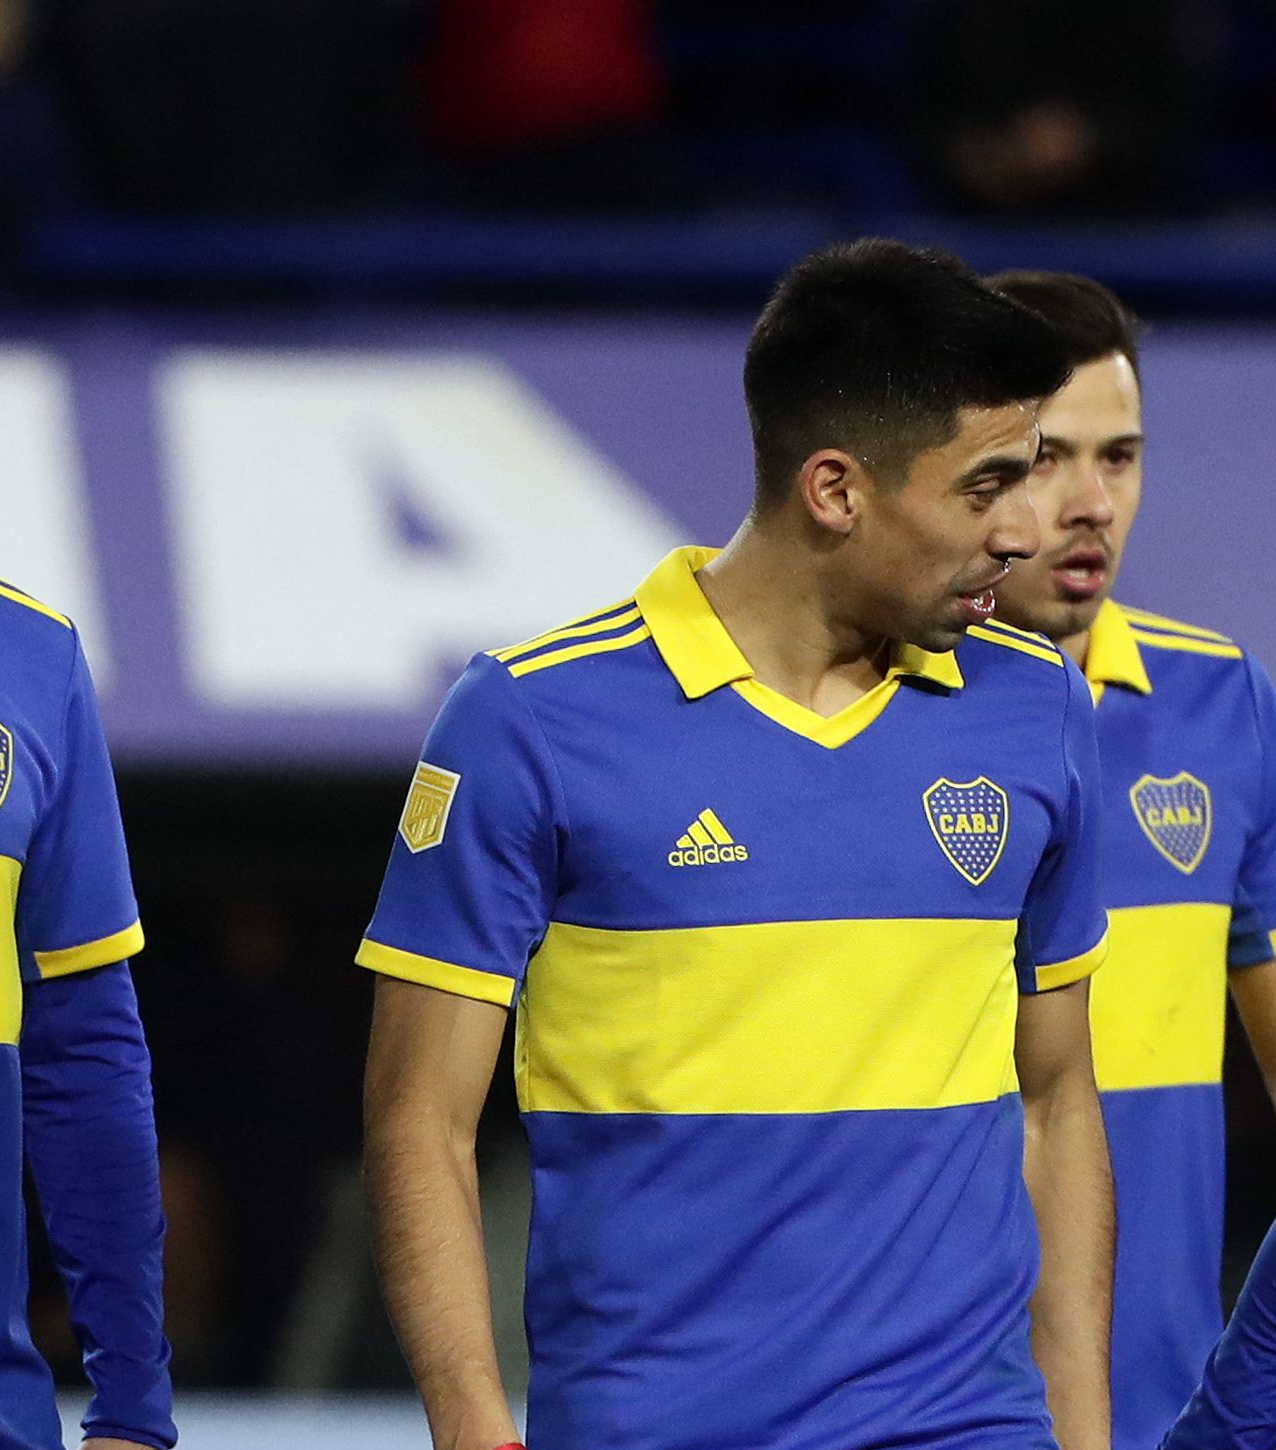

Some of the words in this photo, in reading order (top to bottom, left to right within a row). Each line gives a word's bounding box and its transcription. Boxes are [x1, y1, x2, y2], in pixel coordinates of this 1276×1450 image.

[938, 814, 999, 835] CABJ
[1147, 806, 1202, 826] CABJ
[668, 843, 749, 867] adidas
